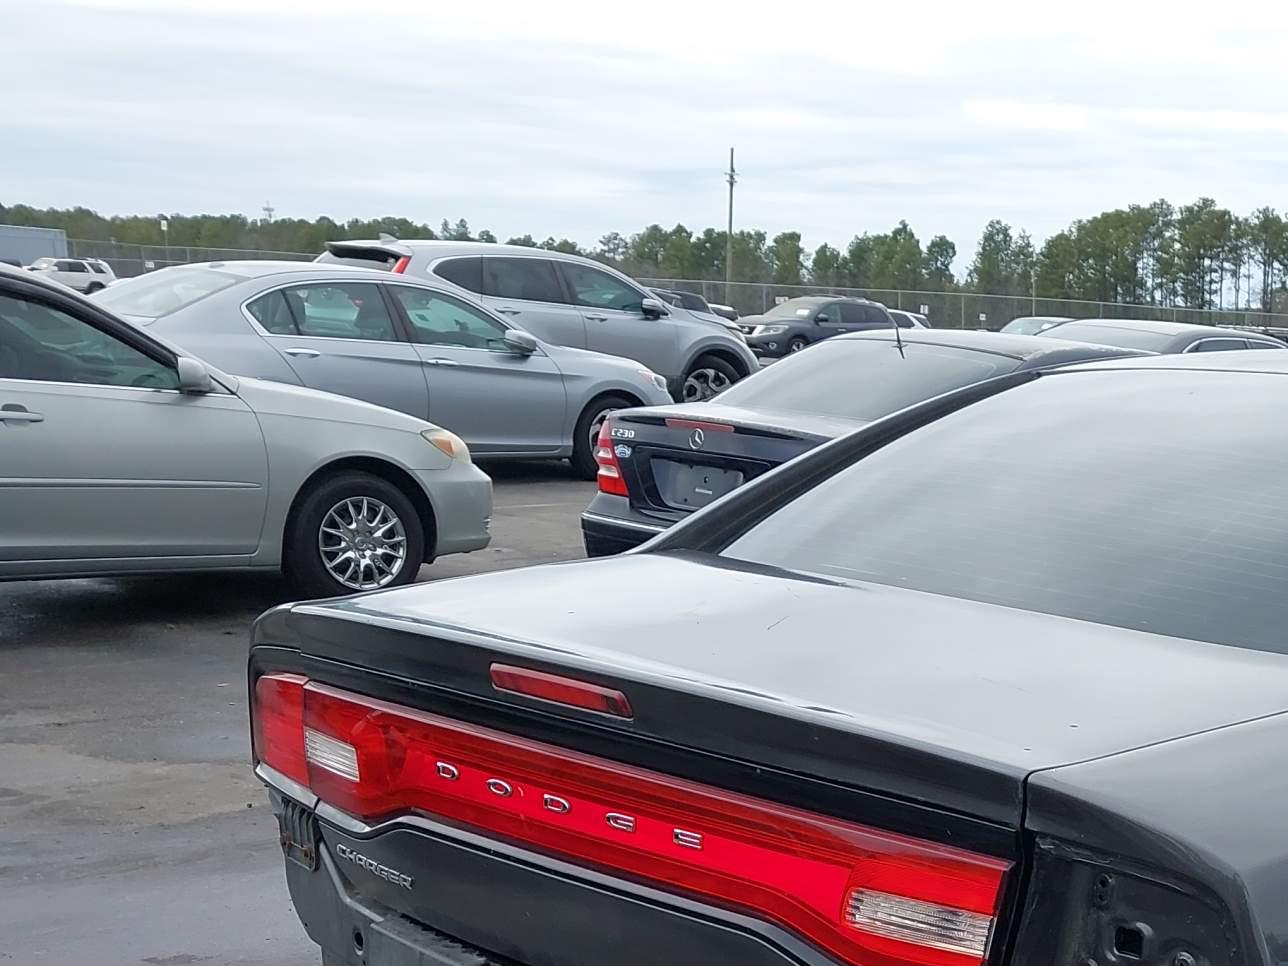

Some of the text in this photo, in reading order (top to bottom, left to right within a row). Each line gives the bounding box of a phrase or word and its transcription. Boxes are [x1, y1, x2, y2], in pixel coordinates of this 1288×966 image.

[611, 428, 635, 438] C230
[436, 761, 703, 850] DODGE
[336, 843, 413, 891] CHARGER
